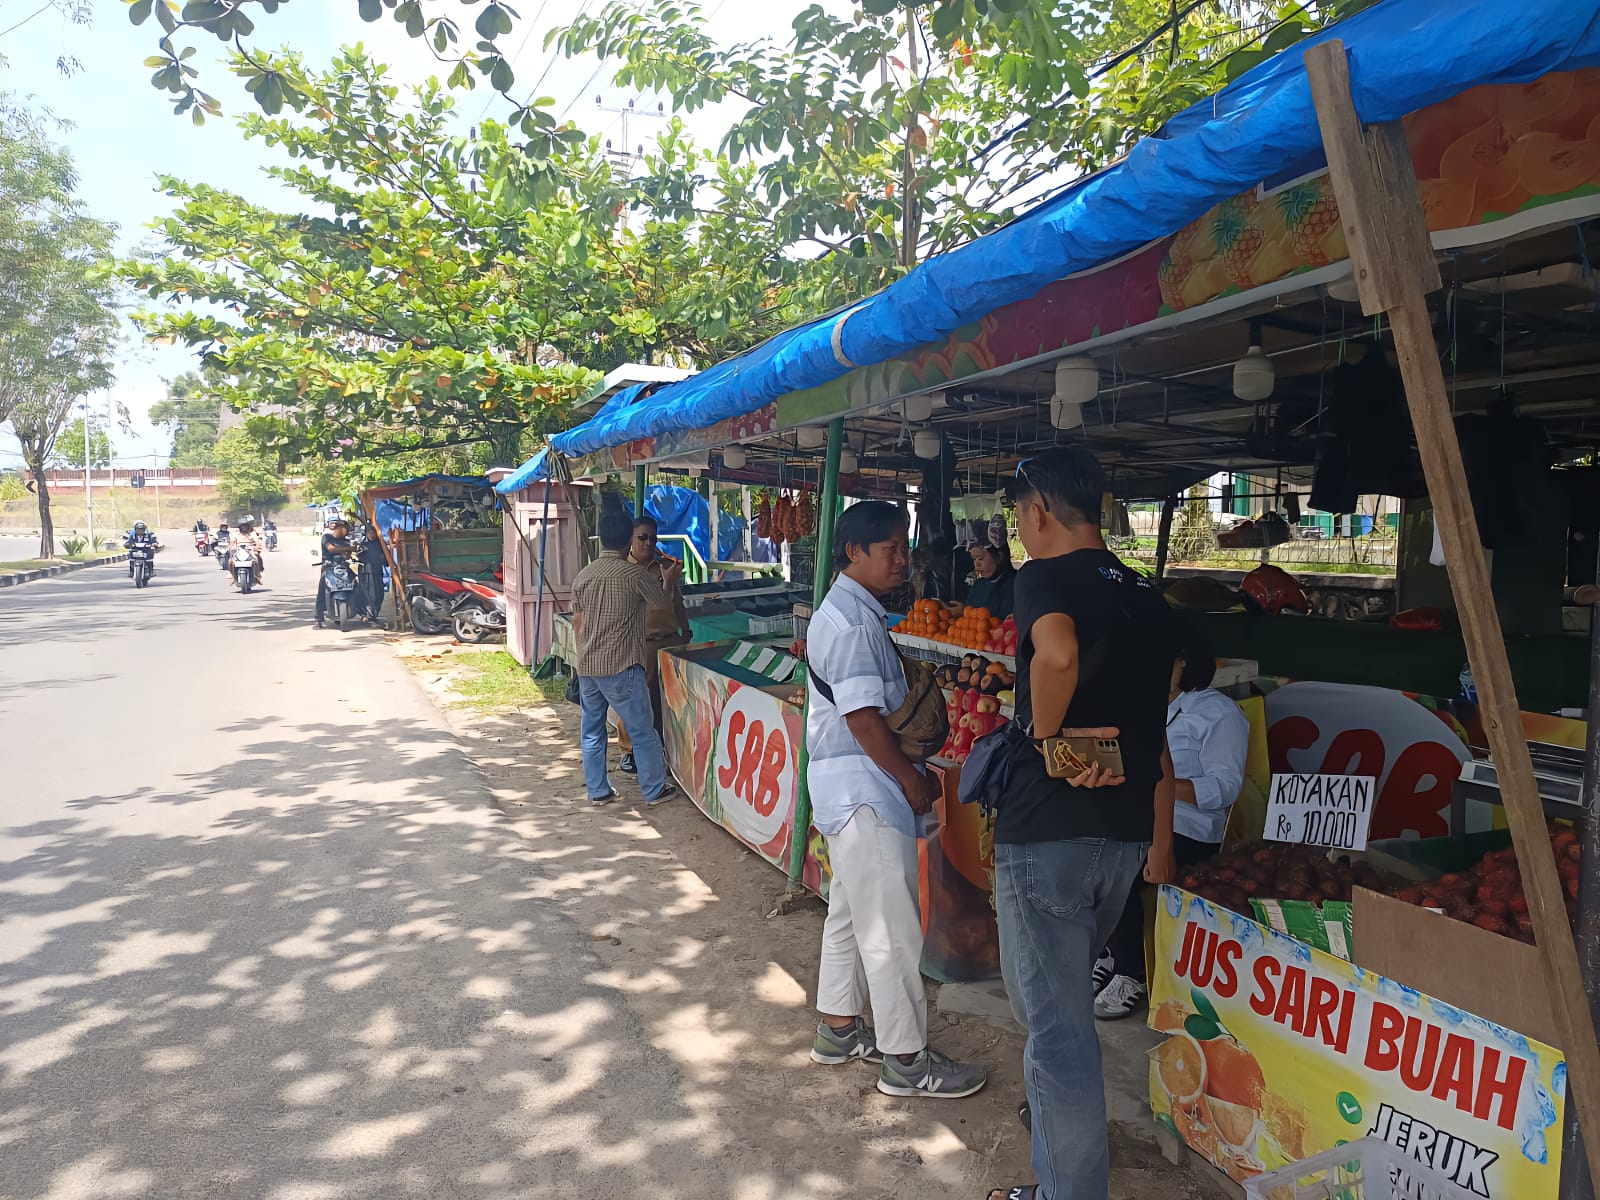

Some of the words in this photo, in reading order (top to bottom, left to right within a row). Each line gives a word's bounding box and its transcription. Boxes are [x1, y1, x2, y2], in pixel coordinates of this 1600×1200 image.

[718, 710, 786, 817] SRB
[1275, 774, 1369, 813] KOYAKAN
[1300, 810, 1357, 849] 10.000
[1173, 921, 1243, 998] JUS
[1249, 955, 1356, 1054] SARI
[1364, 1001, 1527, 1131] BUAH
[1366, 1103, 1500, 1199] JERUK
